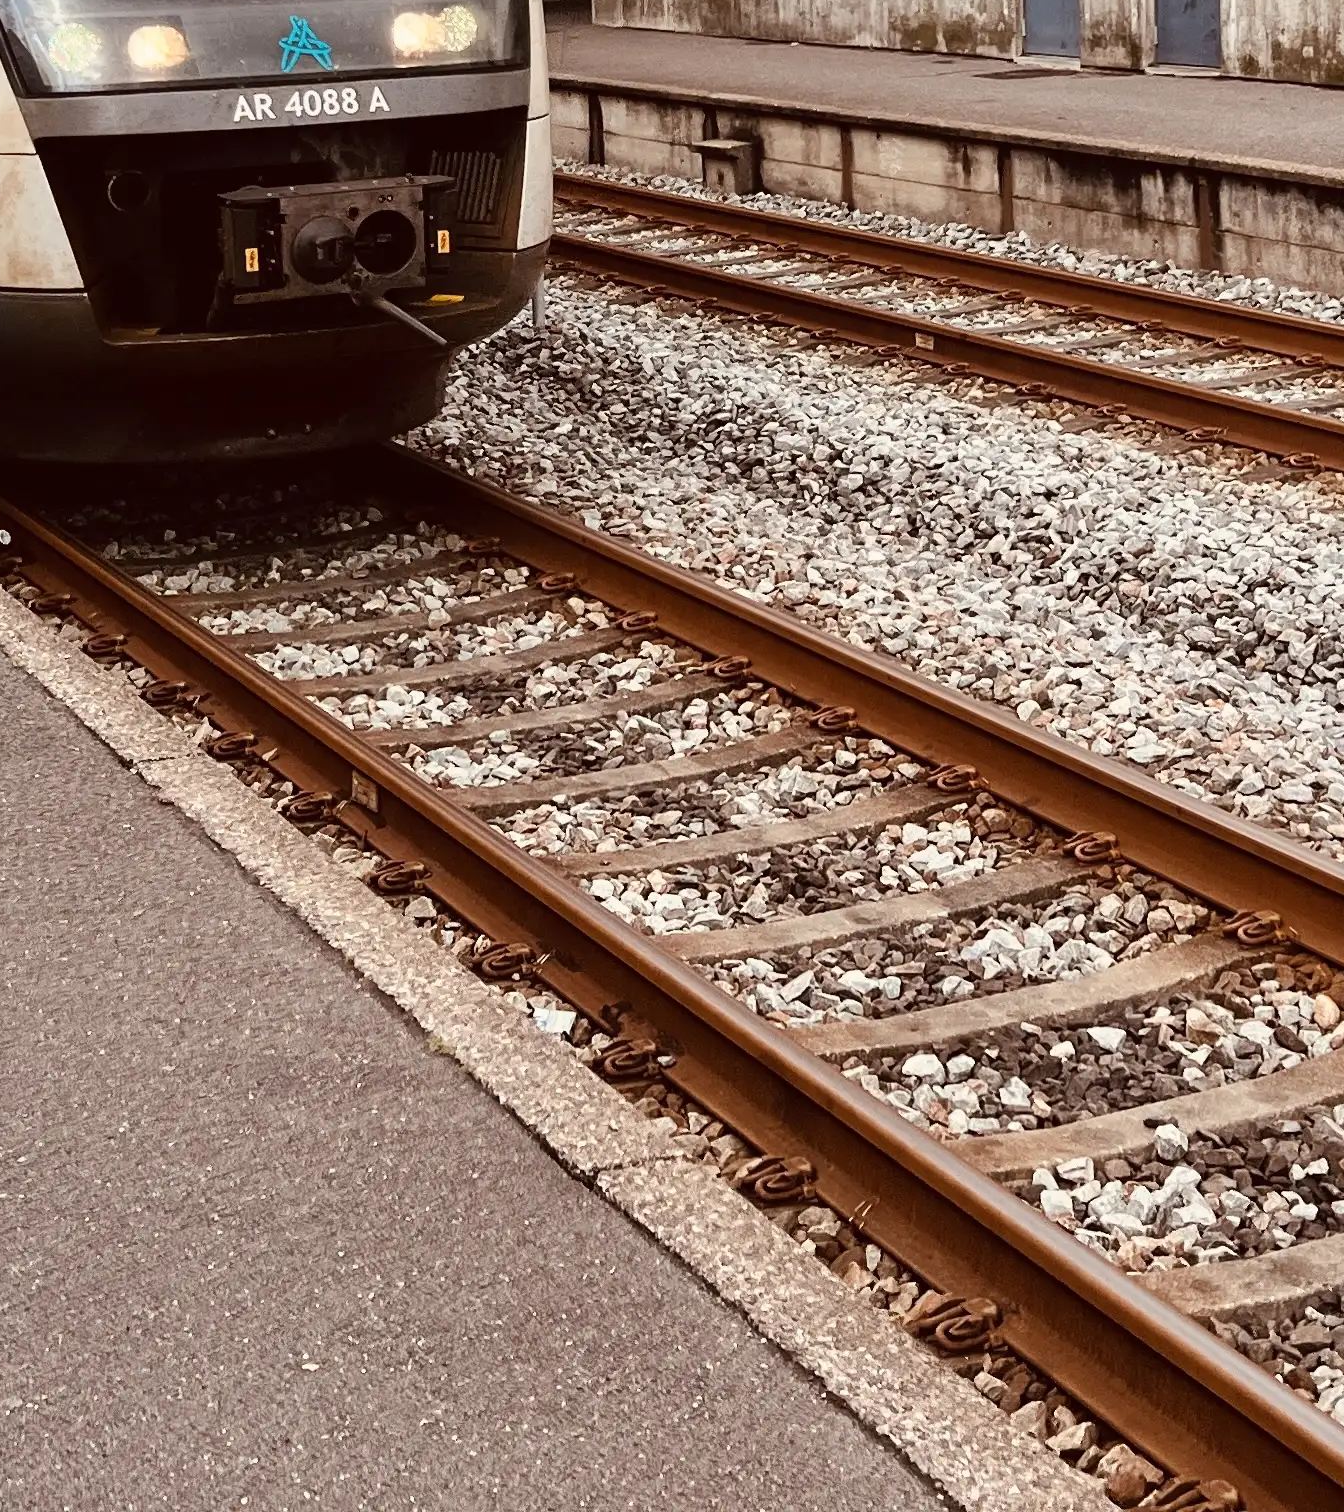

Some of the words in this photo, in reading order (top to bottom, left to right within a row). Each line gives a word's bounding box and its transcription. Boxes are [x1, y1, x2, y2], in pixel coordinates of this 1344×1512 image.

[233, 93, 277, 122] AR
[284, 87, 359, 118] 4088
[369, 85, 391, 113] A
